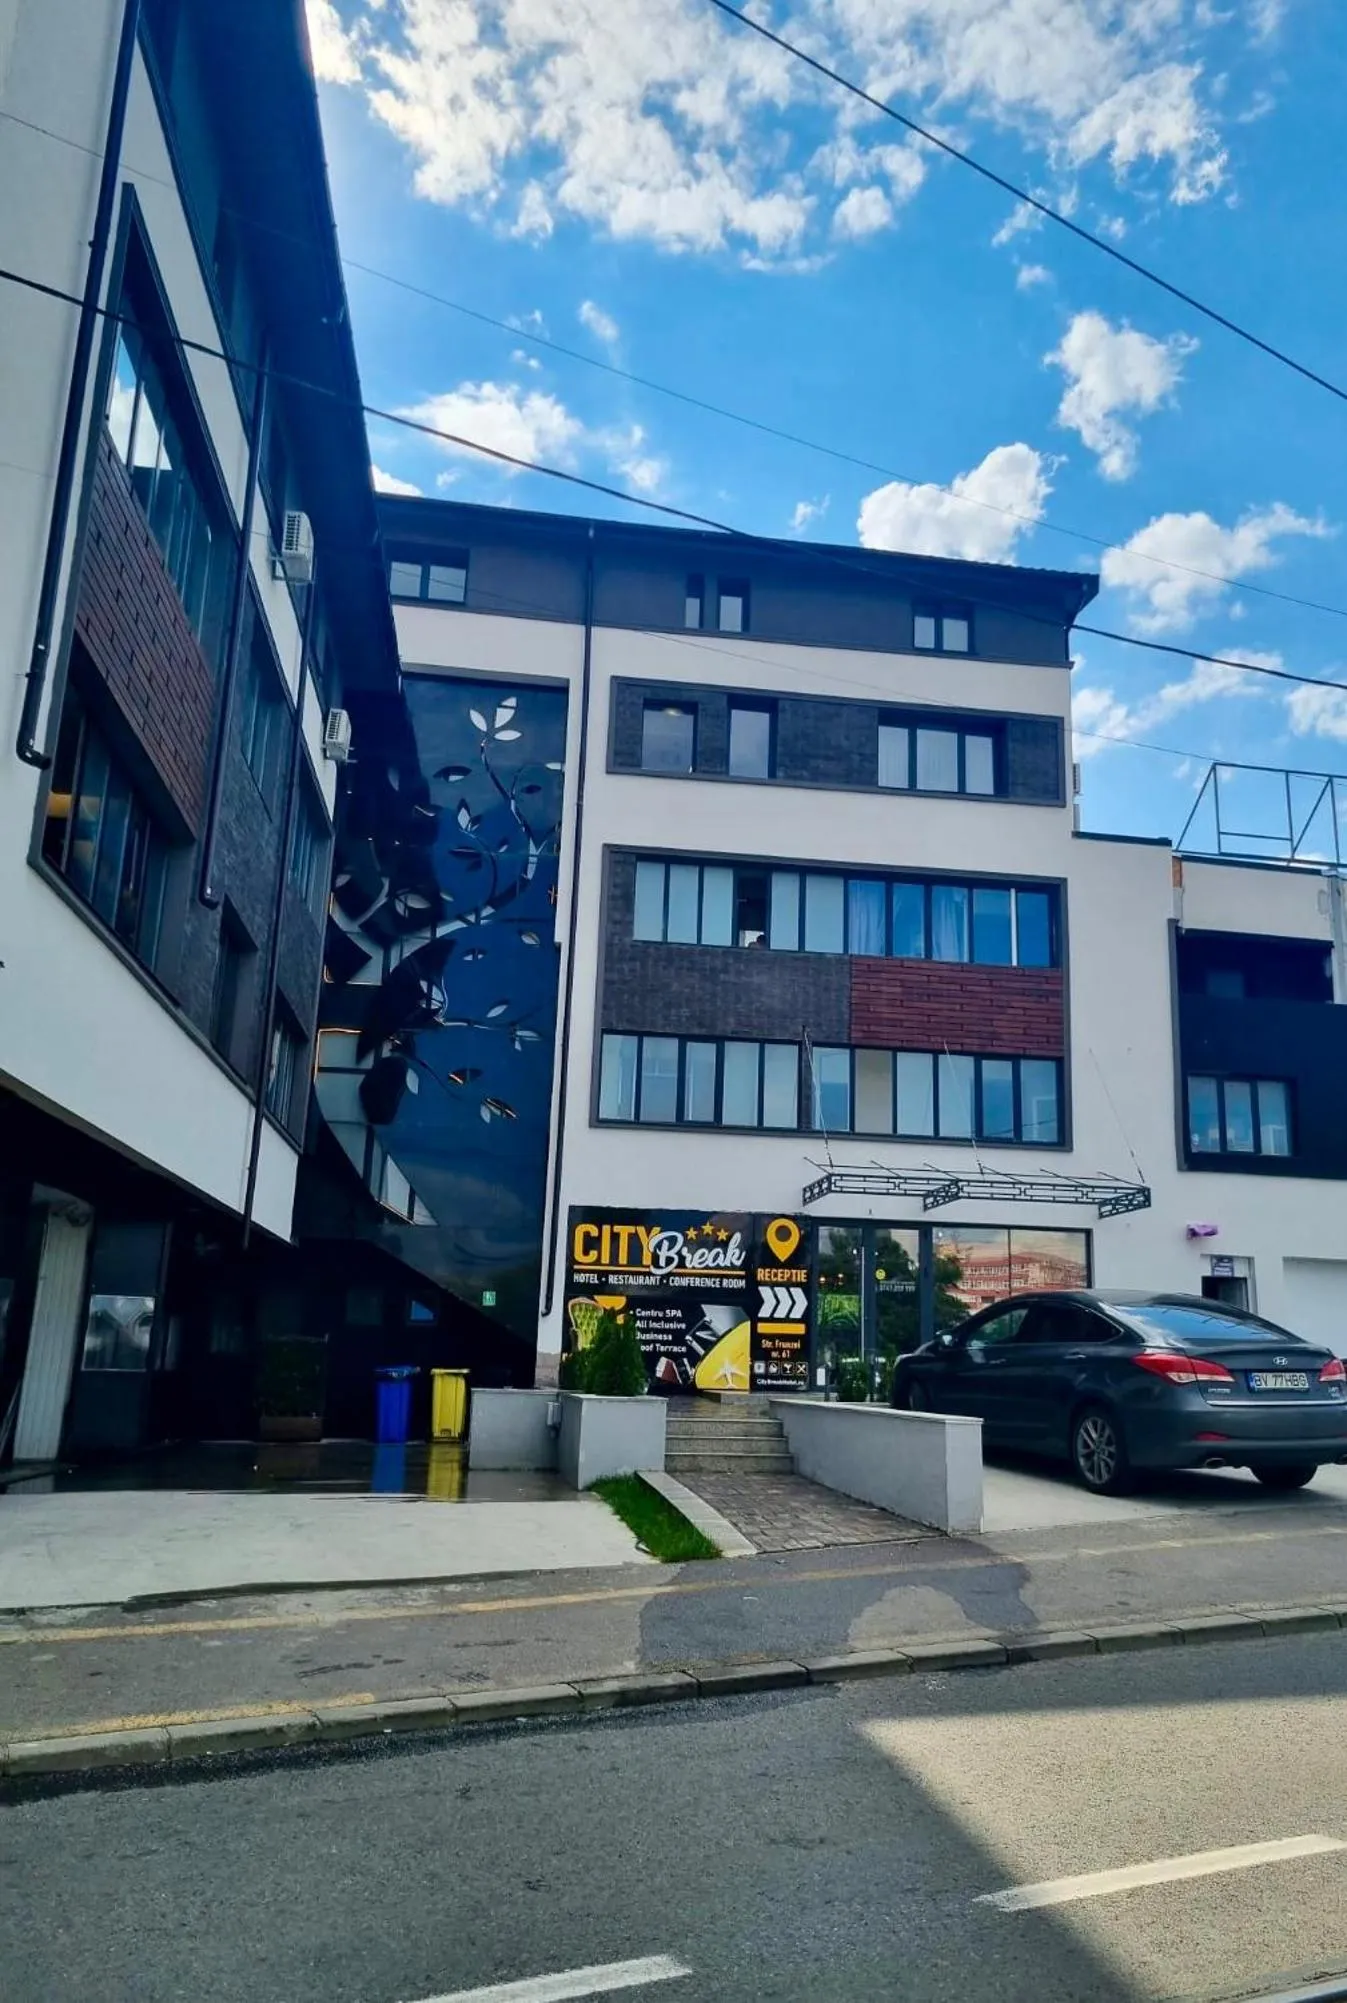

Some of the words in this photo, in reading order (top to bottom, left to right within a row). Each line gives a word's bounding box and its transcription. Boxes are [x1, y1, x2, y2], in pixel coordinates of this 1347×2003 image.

[574, 1223, 661, 1266] CITY
[649, 1231, 746, 1275] Break
[574, 1273, 599, 1284] HOTEL
[608, 1274, 661, 1286] RESTAURANT
[669, 1276, 721, 1288] CONFERENCE
[722, 1278, 746, 1289] ROOM
[757, 1269, 808, 1282] RECEPTIE
[635, 1308, 664, 1317] Centru
[665, 1309, 682, 1318] SPA
[635, 1320, 647, 1328] All
[649, 1320, 686, 1329] Inclusive
[655, 1343, 687, 1352] Terrace
[782, 1350, 790, 1358] 61
[1253, 1375, 1268, 1387] BV
